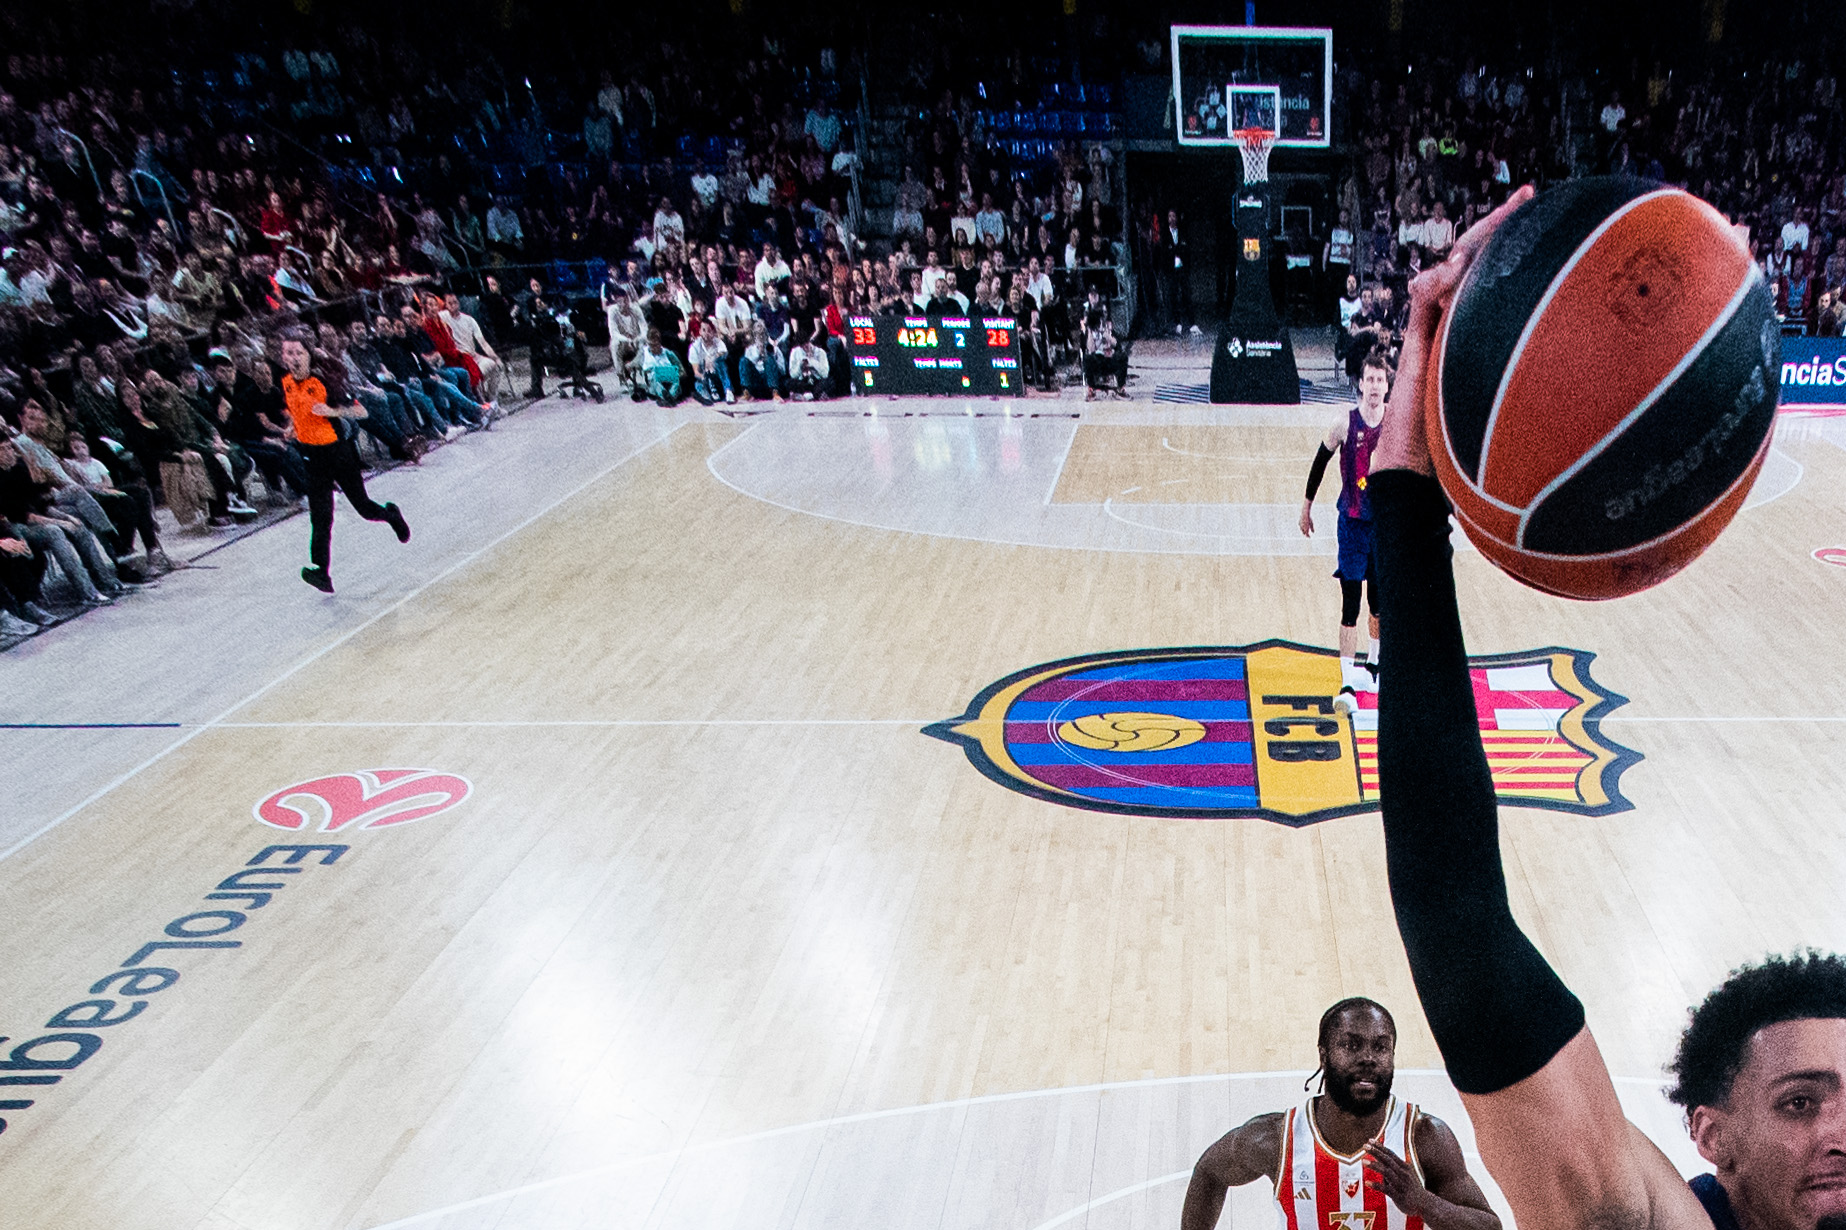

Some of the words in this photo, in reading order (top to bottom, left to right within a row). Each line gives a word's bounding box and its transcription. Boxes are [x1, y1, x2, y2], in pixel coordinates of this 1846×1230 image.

[852, 328, 876, 346] 33
[897, 328, 939, 347] 4:24
[955, 331, 966, 347] 2
[987, 328, 1010, 347] 28
[1000, 371, 1010, 388] 1
[1261, 694, 1342, 763] FCB
